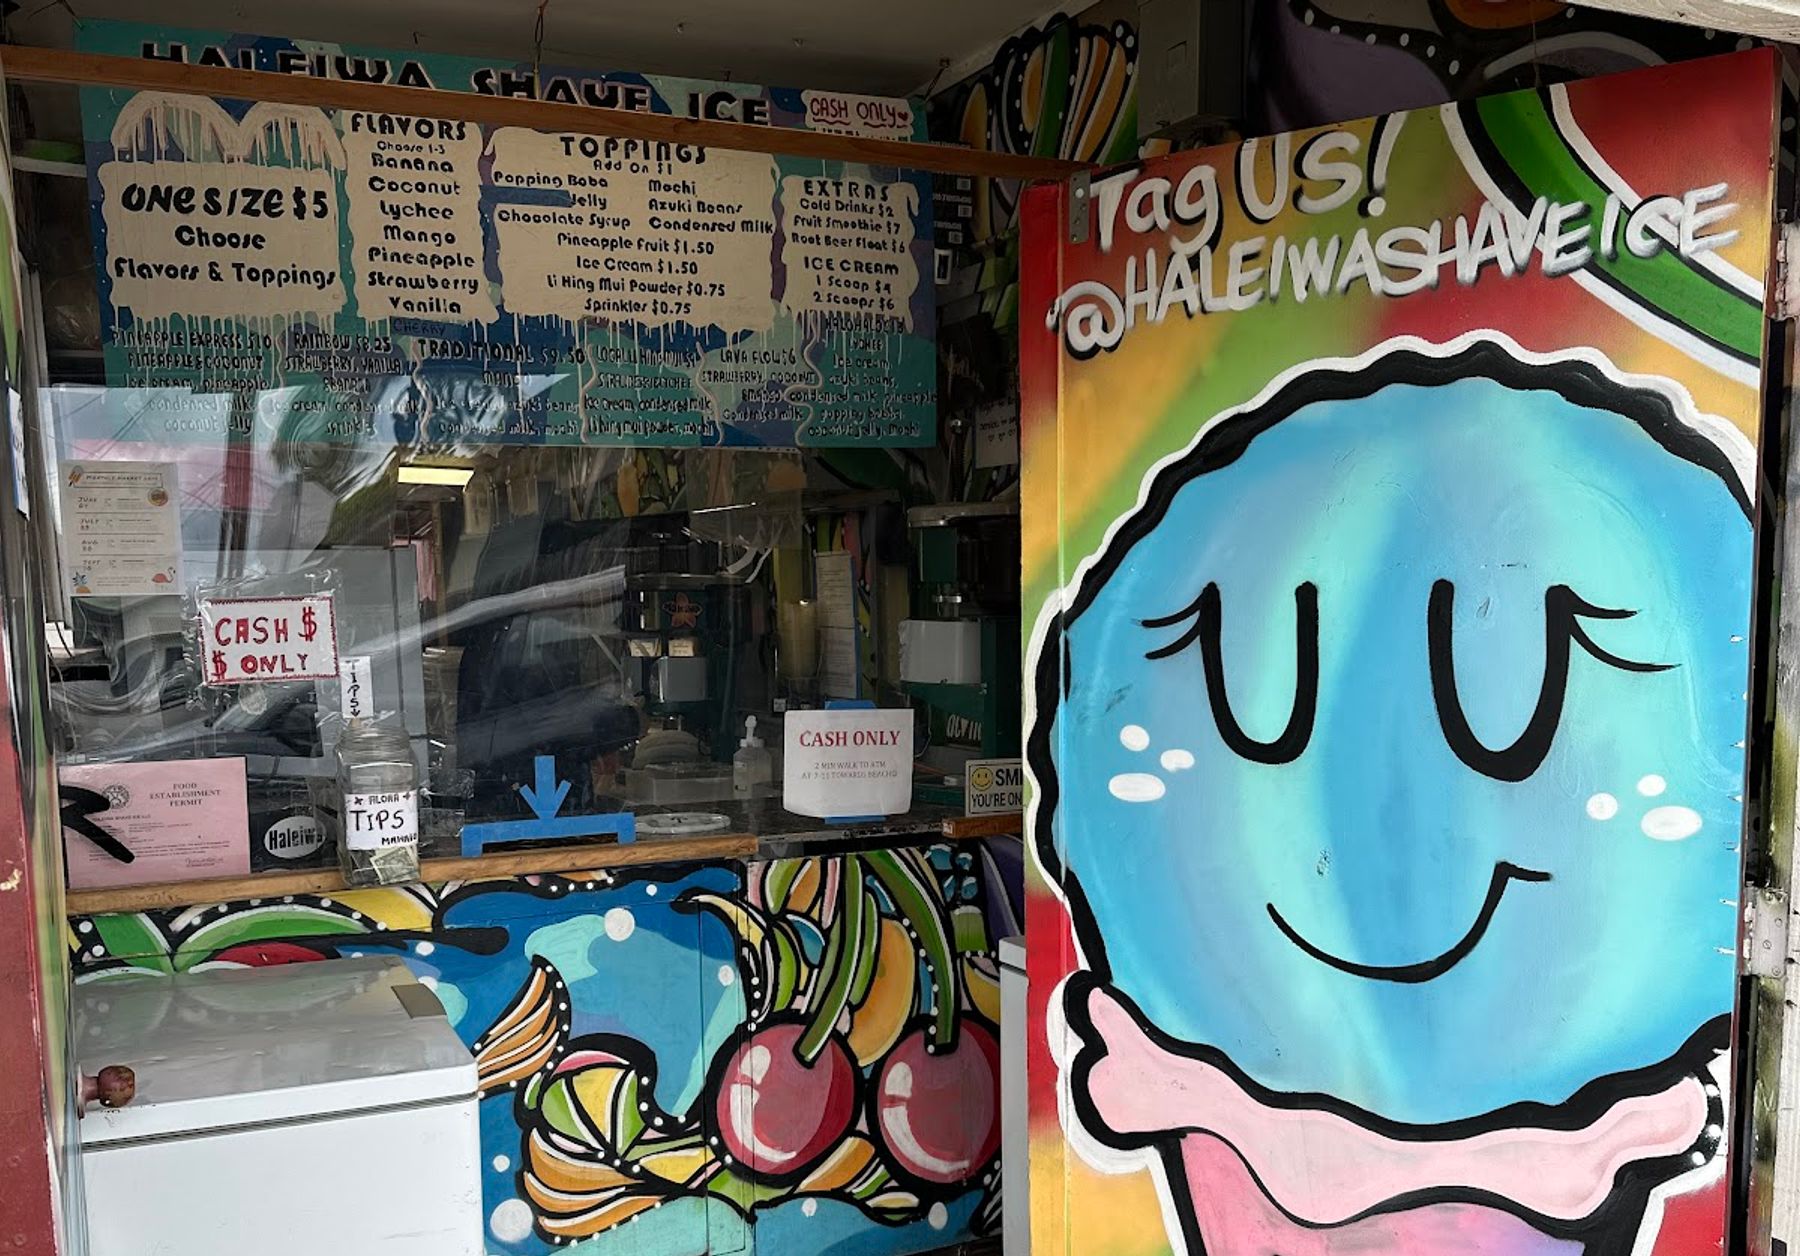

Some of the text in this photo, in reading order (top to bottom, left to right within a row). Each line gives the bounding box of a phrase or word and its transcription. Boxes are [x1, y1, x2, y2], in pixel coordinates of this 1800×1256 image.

[687, 91, 770, 126] ICE
[809, 96, 897, 127] CASH ONLY
[351, 112, 466, 140] FLAVORS
[376, 140, 446, 155] Choose 1-3
[560, 136, 706, 164] TOPPINGS
[370, 152, 454, 173] Banana
[593, 159, 672, 175] Add On $1
[367, 175, 461, 195] Coconut
[493, 170, 608, 188] Popping Boba
[648, 179, 696, 196] Mochi
[1088, 110, 1412, 258] Tag US!
[803, 179, 889, 202] EXTRAS
[292, 185, 329, 220] $5
[379, 199, 454, 220] Lychee
[648, 198, 743, 214] Azuki Beans
[799, 198, 894, 218] Cold Drinks $2
[497, 208, 631, 231] Chocolate Syrup
[648, 215, 774, 234] Condensed Milk
[793, 214, 901, 235] Fruit Smoothie $7
[174, 225, 267, 250] Choose
[382, 224, 457, 247] Mango
[556, 232, 715, 256] Pineapple Fruit $1.50
[791, 232, 905, 253] Root Beer Float $6
[367, 246, 476, 269] Pineapple
[576, 254, 699, 275] Ice Cream $1.50
[803, 255, 899, 275] ICE CREAM
[113, 258, 336, 289] Flavors & Toppings
[367, 270, 479, 294] Strawberry
[816, 273, 891, 294] 1 Scoop $4
[547, 274, 726, 297] Li Hing Mui Powder $0.75
[388, 296, 462, 314] Vanilla
[584, 297, 692, 316] Sprinkles $0.75
[812, 290, 895, 311] 2 Scoops $6
[391, 319, 447, 336] CHERRY
[111, 331, 272, 350] PINEAPPLE EXPRESS $10
[294, 332, 351, 351] RAINBOW
[417, 338, 586, 366] TRADITIONAL $9.50
[720, 348, 748, 365] LAVA
[214, 606, 317, 646] CASH $
[211, 650, 309, 681] $ ONLY
[345, 658, 361, 708] TIPS
[799, 730, 901, 748] CASH ONLY
[837, 761, 858, 769] WALK
[870, 760, 887, 768] ATM
[150, 789, 221, 800] ESTABLISHMENT
[169, 799, 203, 807] PERMIT
[971, 793, 1006, 809] YOU'RE
[349, 809, 405, 832] TIPS
